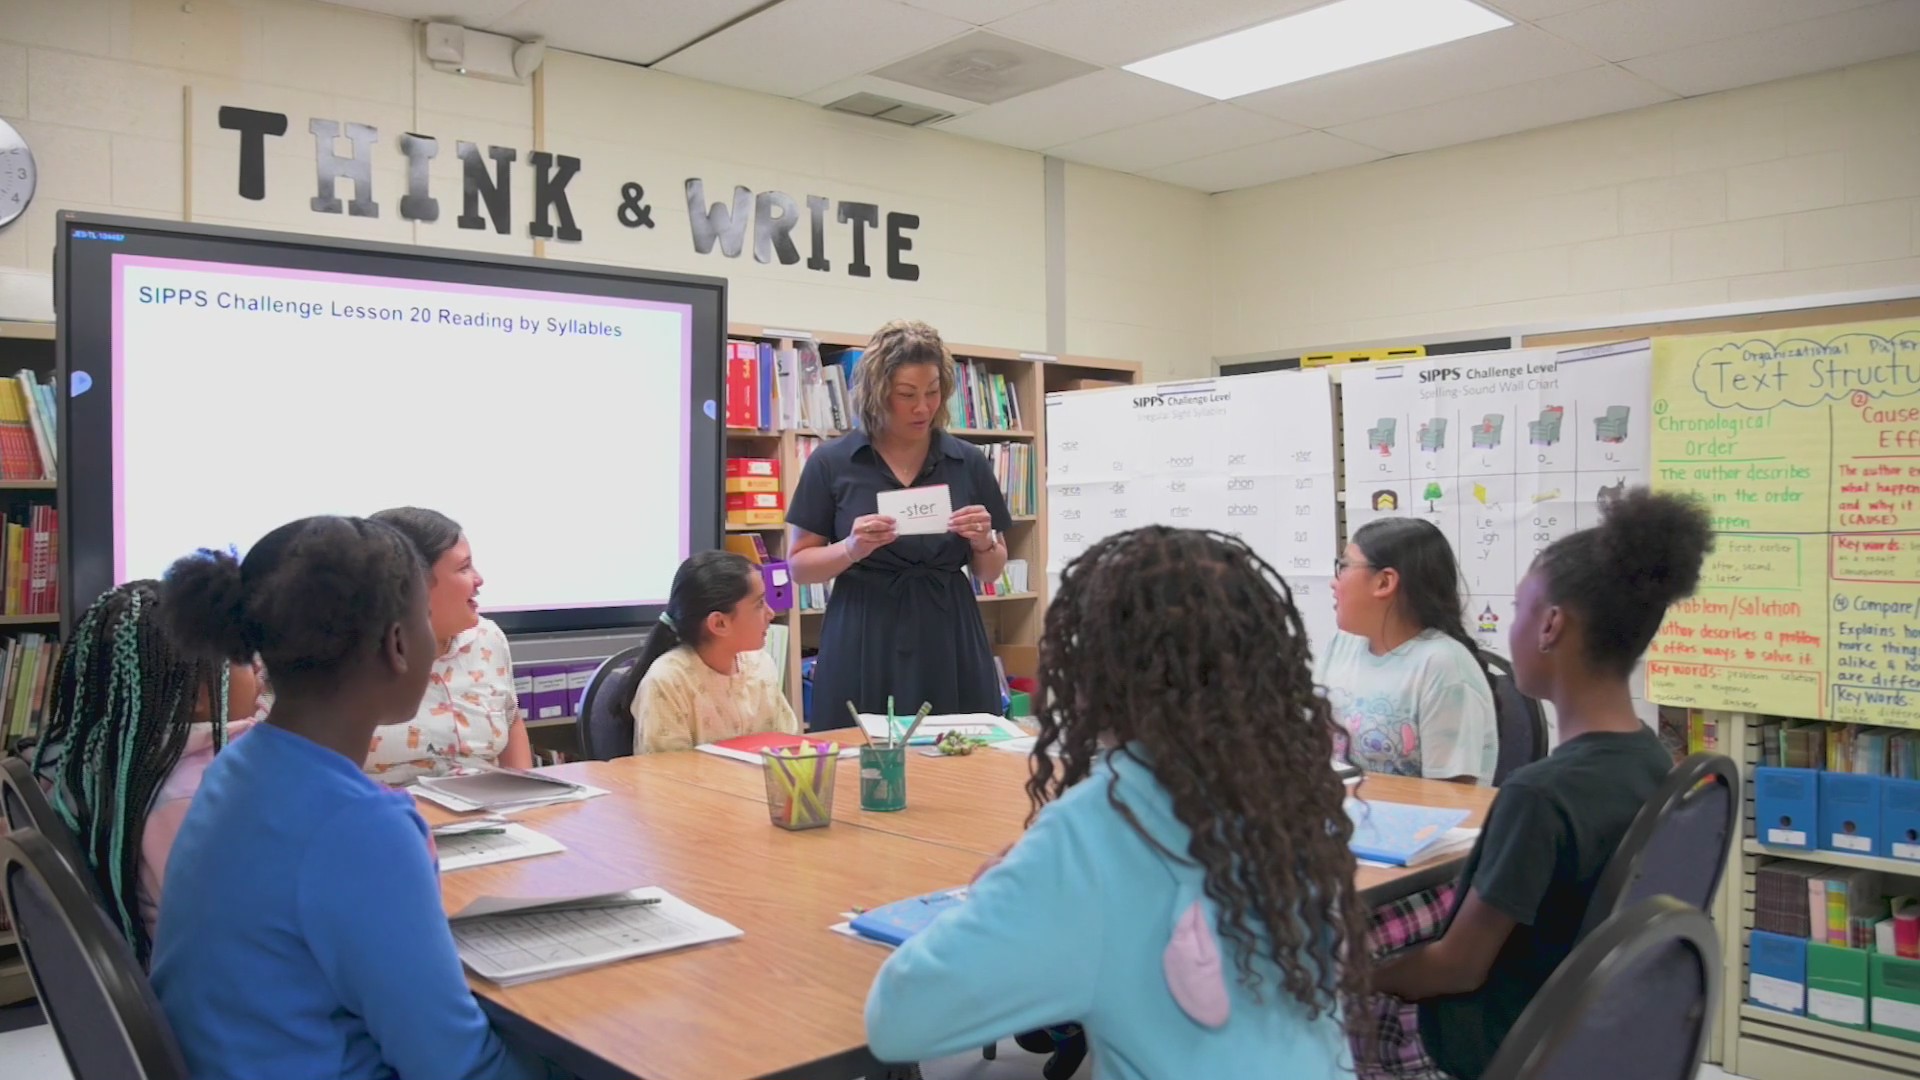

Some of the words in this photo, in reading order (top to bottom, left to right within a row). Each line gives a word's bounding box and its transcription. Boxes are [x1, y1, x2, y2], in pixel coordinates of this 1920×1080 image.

[17, 167, 28, 180] 3
[11, 192, 20, 204] 4
[218, 105, 582, 241] THINK
[617, 182, 655, 228] &
[684, 177, 920, 281] WRITE
[138, 286, 208, 308] SIPPS
[216, 292, 324, 319] Challenge
[331, 300, 404, 322] Lesson
[409, 307, 432, 324] 20
[438, 309, 514, 333] Reading
[519, 315, 541, 335] by
[546, 317, 623, 337] Syllables
[1418, 367, 1461, 384] SIPPS
[1466, 365, 1524, 380] Challenge
[1526, 361, 1558, 375] Level
[1710, 360, 1789, 393] Text
[1419, 381, 1496, 400] Spelling-Sound
[1500, 380, 1525, 392] Wall
[1527, 378, 1560, 391] Chart
[1132, 395, 1164, 409] SIPPS
[1167, 395, 1209, 406] Challenge
[1210, 392, 1231, 403] Level
[1862, 405, 1920, 424] Cause
[1658, 408, 1773, 439] Chronological
[1685, 436, 1739, 457] Order
[1659, 467, 1686, 480] The
[1693, 464, 1740, 480] author
[1746, 463, 1811, 481] describes
[1838, 464, 1857, 477] The
[1862, 464, 1902, 477] author
[1227, 478, 1254, 490] phon
[1841, 481, 1869, 493] what
[1712, 490, 1727, 502] in
[1734, 489, 1759, 502] the
[1764, 486, 1805, 502] order
[899, 502, 938, 519] -ster
[1227, 504, 1258, 517] photo
[1838, 499, 1860, 510] and
[1868, 499, 1895, 513] why
[1532, 517, 1558, 529] o_e
[1708, 516, 1751, 530] appen
[1838, 536, 1860, 553] Key
[1669, 596, 1801, 621] roblem/Solution
[1658, 620, 1696, 638] uthor
[1700, 624, 1757, 641] describes
[1764, 630, 1773, 641] a
[1839, 621, 1896, 641] Explains
[1702, 647, 1737, 662] ways
[1743, 648, 1756, 660] to
[1761, 650, 1793, 663] solve
[1837, 641, 1873, 653] more
[1650, 662, 1668, 677] Key
[1837, 655, 1877, 670] alike
[1837, 671, 1865, 683] are
[1838, 684, 1862, 706] Key
